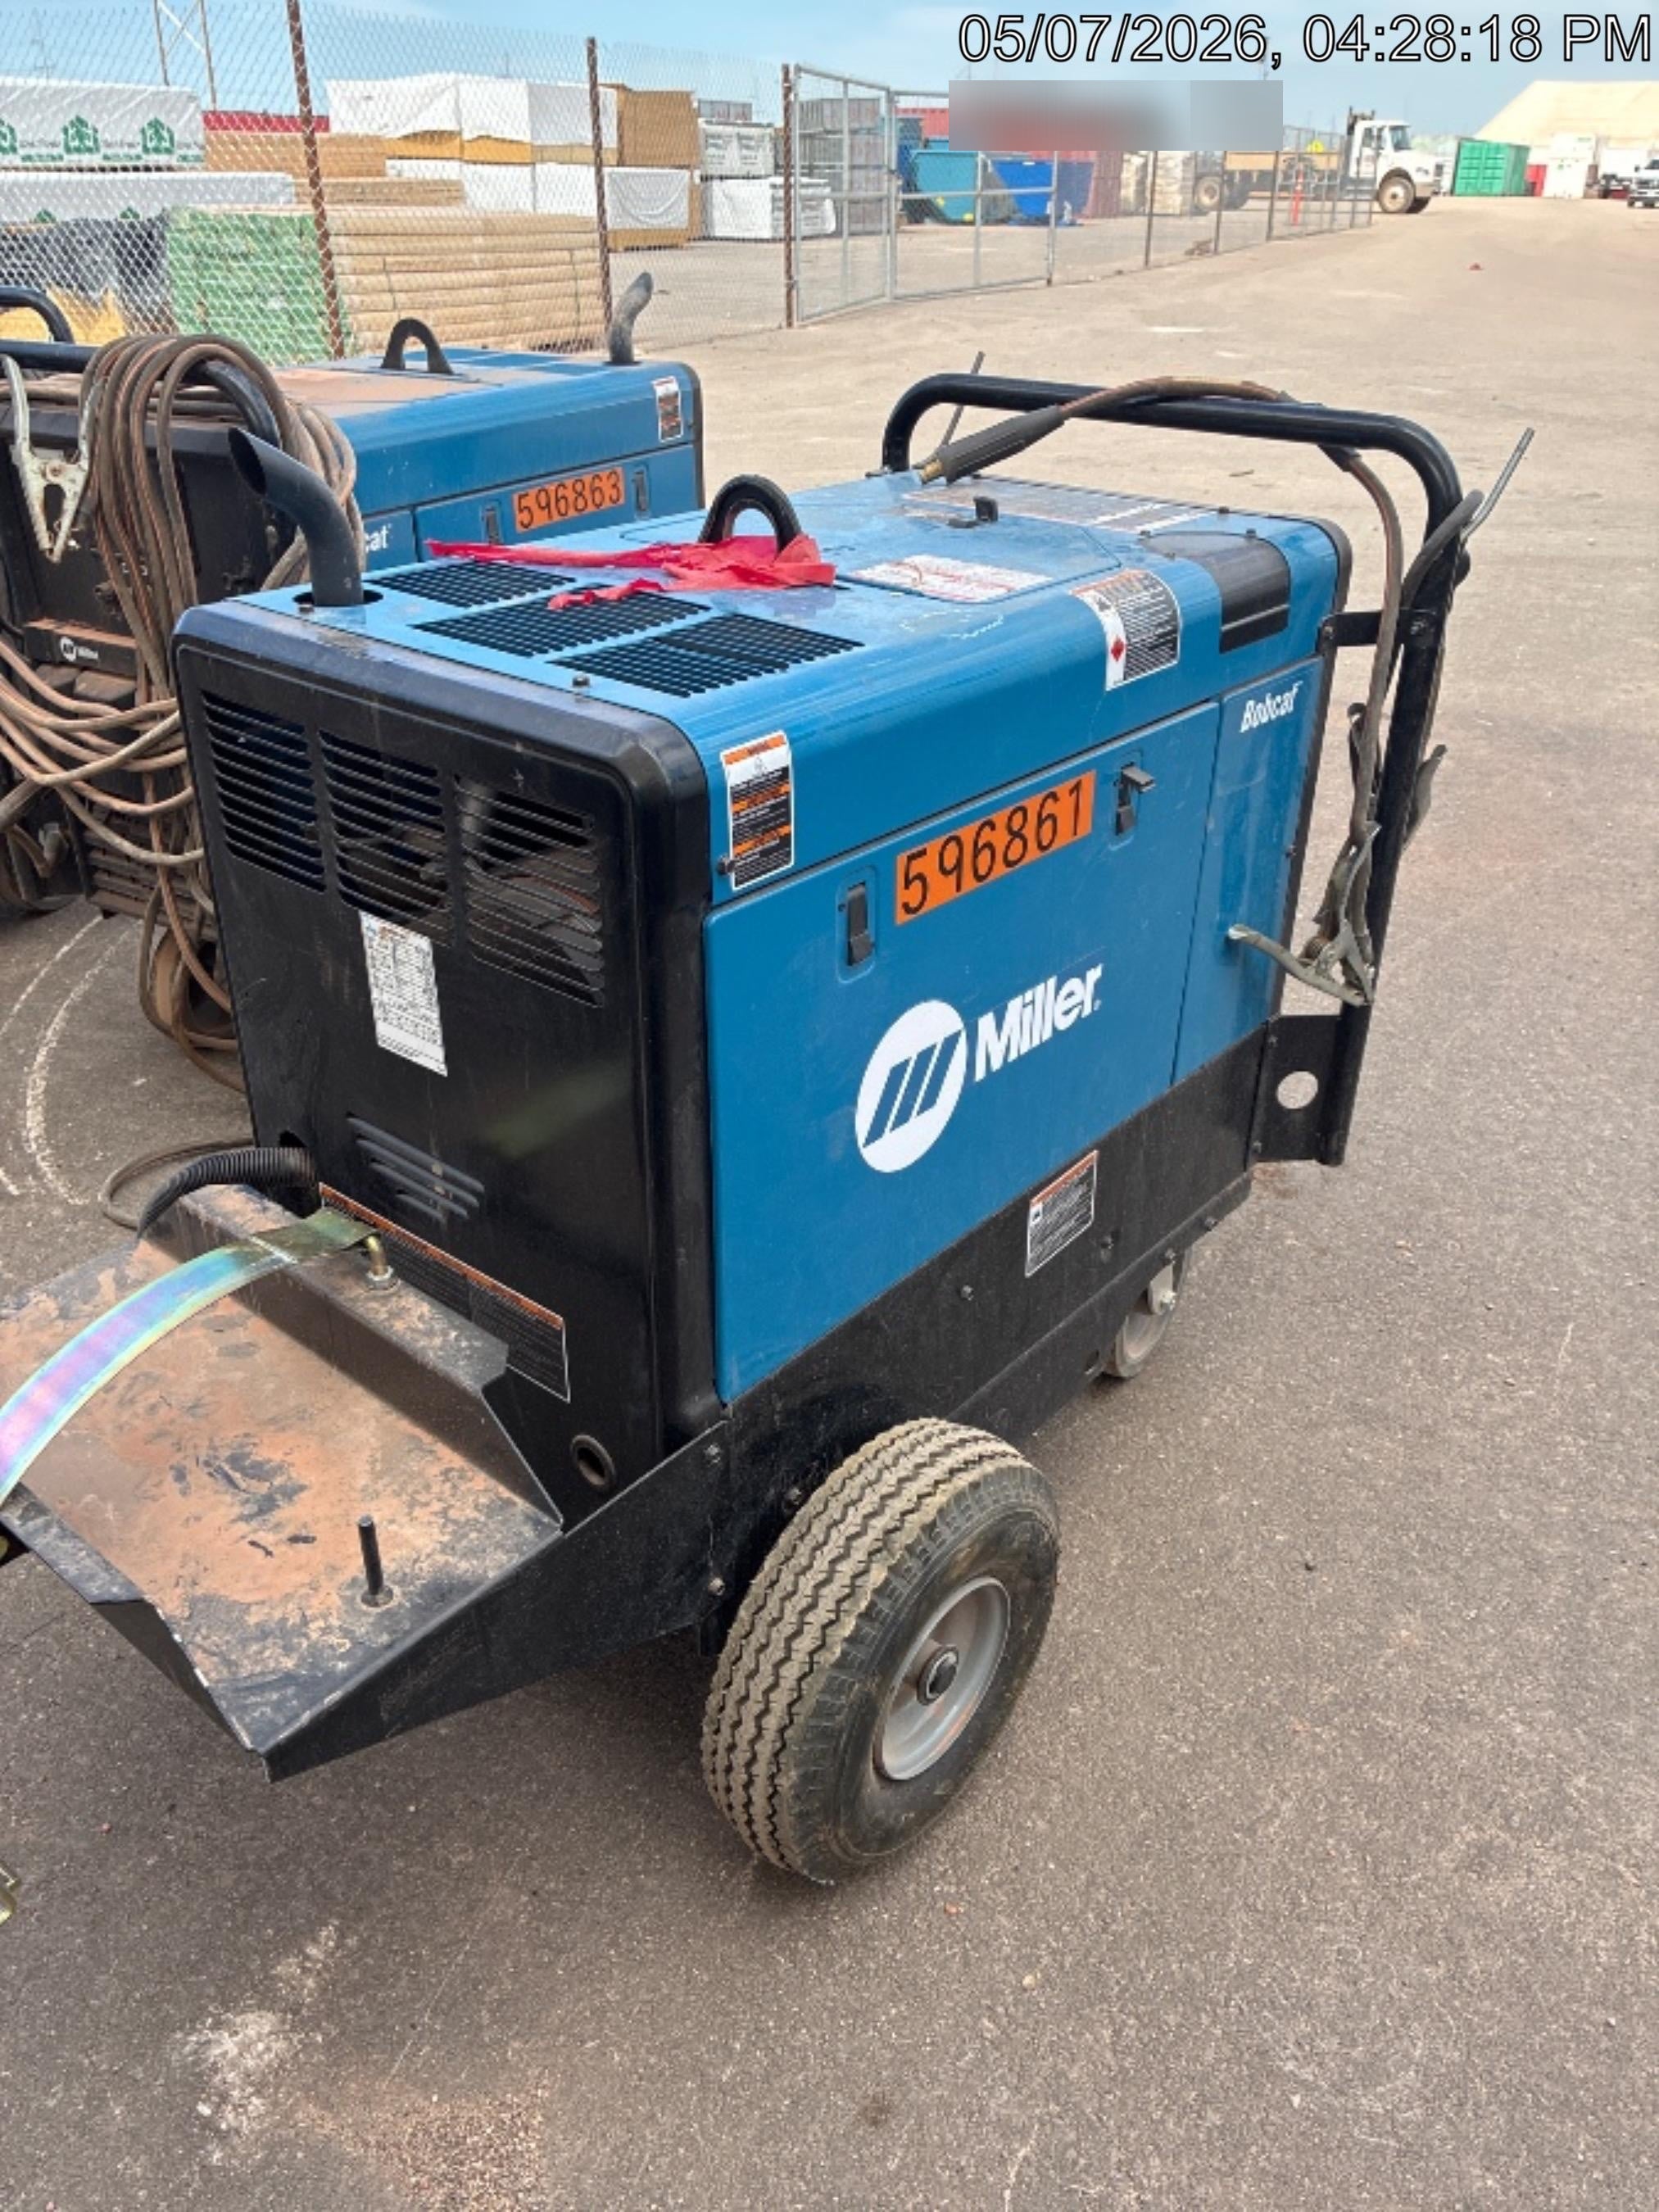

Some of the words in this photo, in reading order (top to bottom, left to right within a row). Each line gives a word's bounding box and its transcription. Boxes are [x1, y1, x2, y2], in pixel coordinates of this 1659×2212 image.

[517, 469, 623, 531] 596863
[365, 524, 388, 554] cat
[1239, 682, 1299, 733] Bobcat
[901, 778, 1082, 915] 596861
[974, 963, 1104, 1083] Miller
